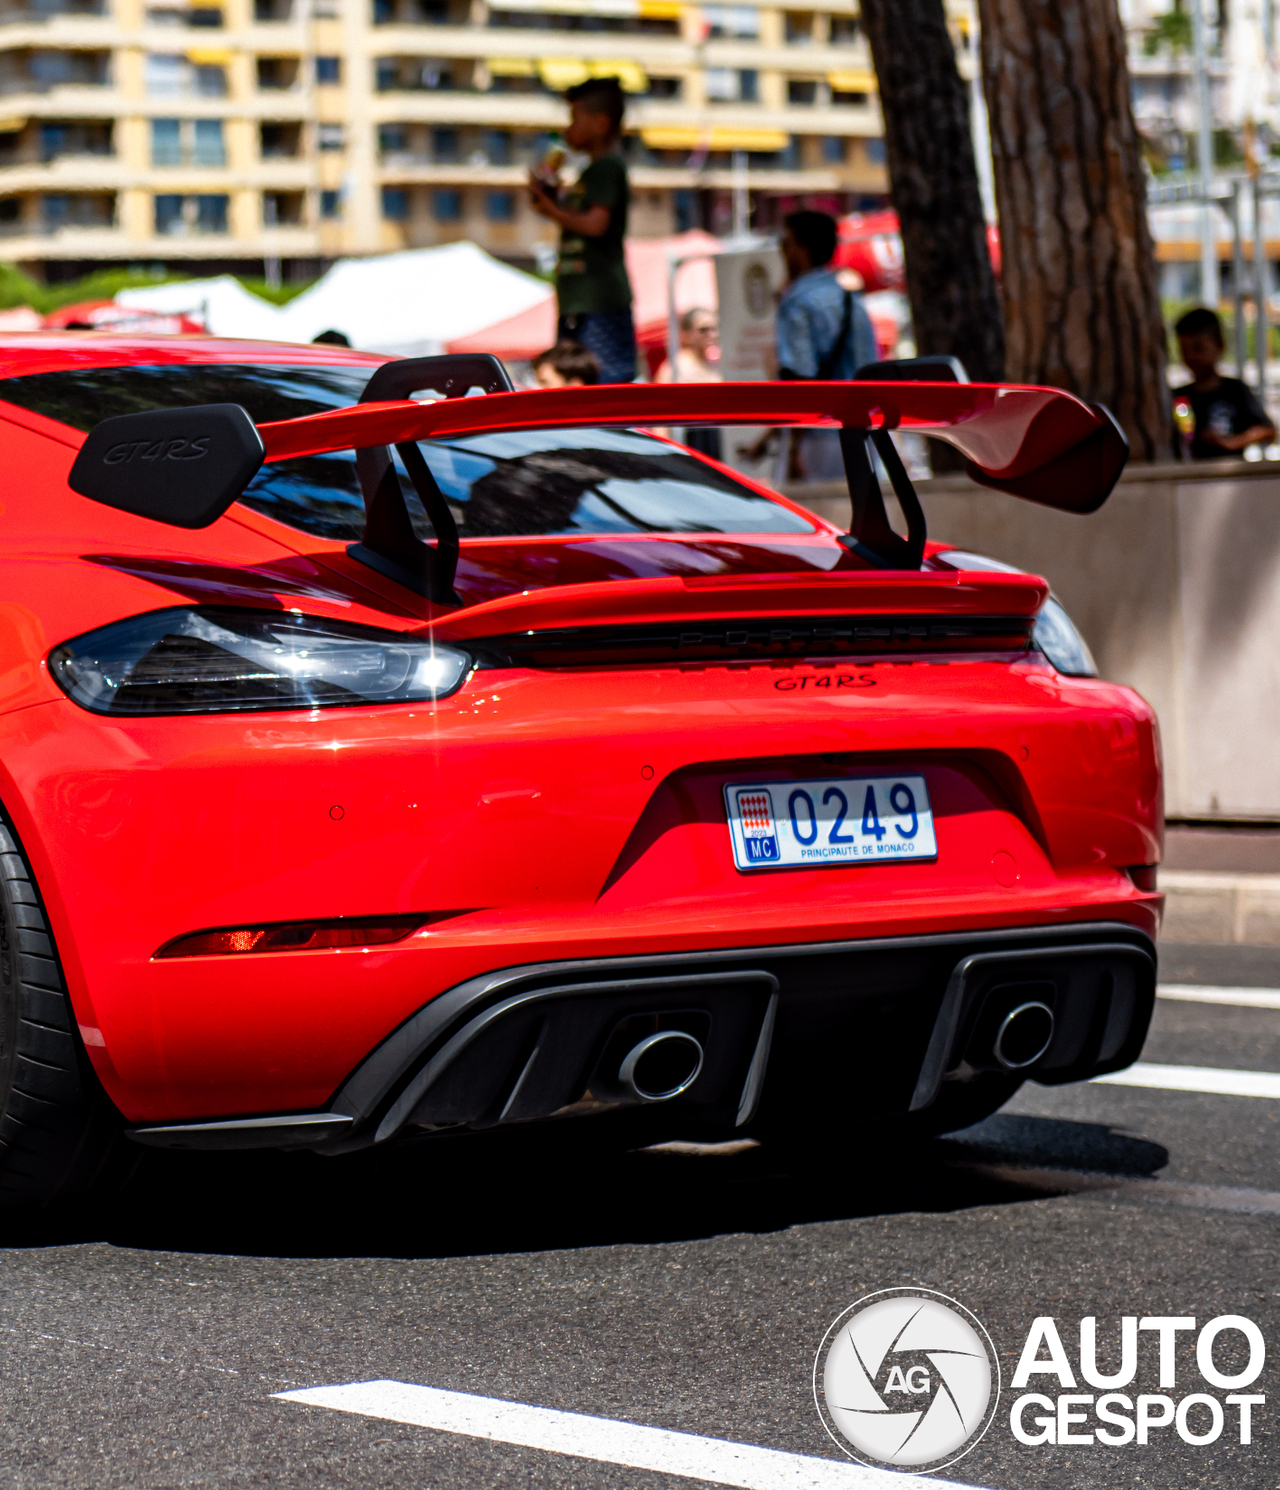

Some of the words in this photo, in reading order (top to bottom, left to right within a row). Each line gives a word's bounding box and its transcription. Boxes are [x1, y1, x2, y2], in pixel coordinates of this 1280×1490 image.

[103, 437, 211, 465] GT4RS
[774, 674, 877, 690] GT4RS
[788, 783, 919, 846] 0249
[750, 830, 768, 838] 2023
[751, 840, 772, 858] MC
[801, 846, 859, 859] PRINCIPAUTE
[862, 845, 874, 855] DE
[877, 843, 915, 853] MONACO
